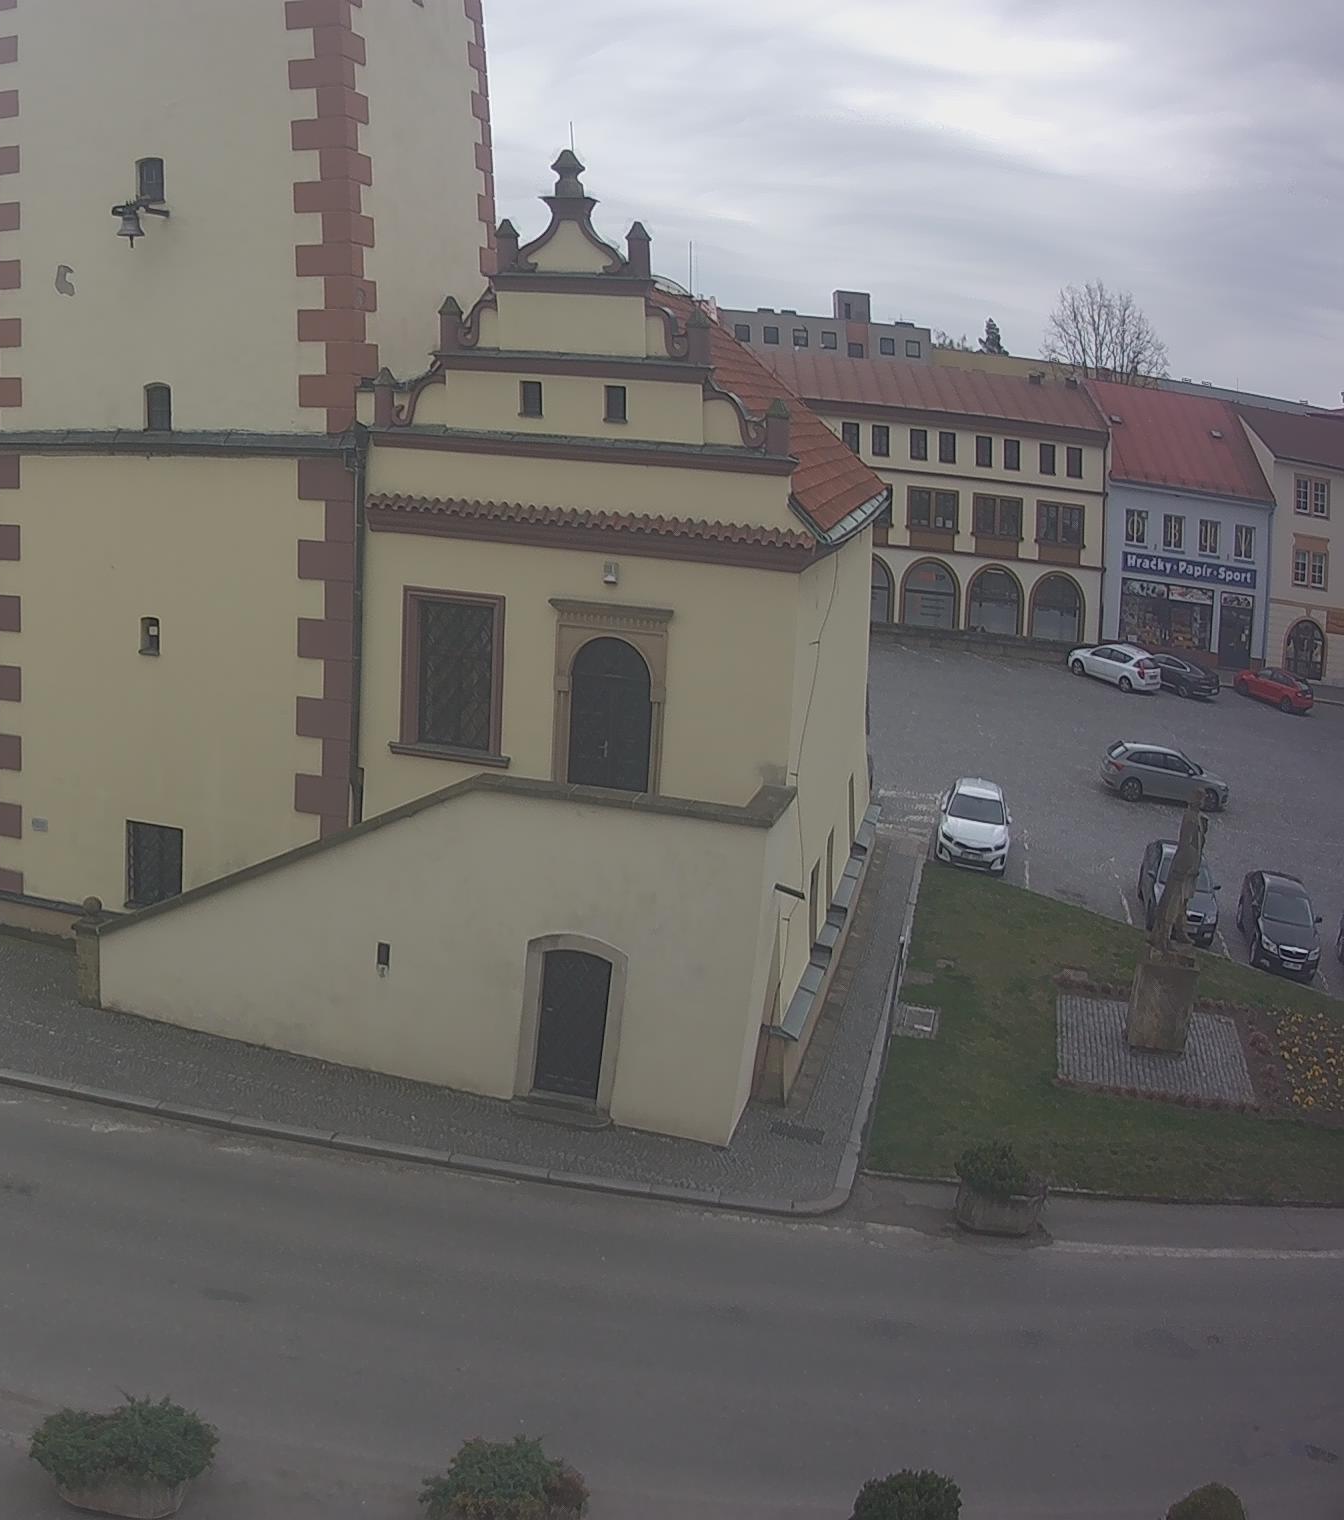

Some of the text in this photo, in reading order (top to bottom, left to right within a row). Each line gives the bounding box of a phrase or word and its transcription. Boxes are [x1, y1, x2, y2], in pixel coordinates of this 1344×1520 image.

[1127, 554, 1251, 583] Hračky Papír Sport
